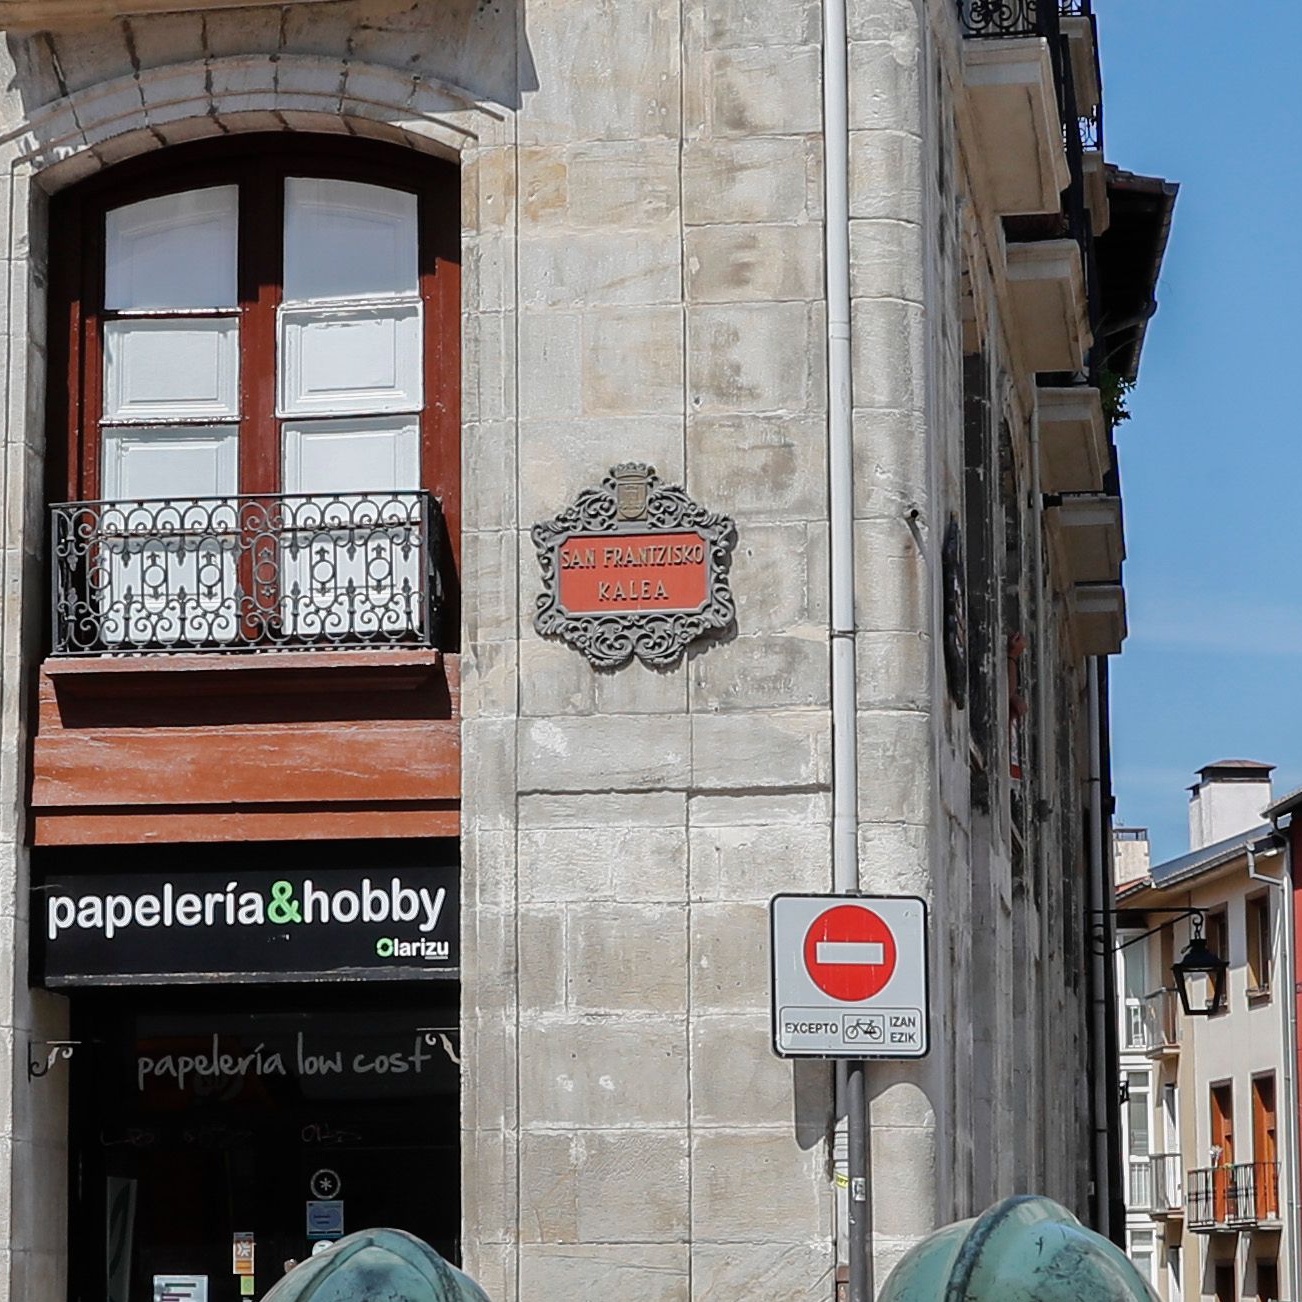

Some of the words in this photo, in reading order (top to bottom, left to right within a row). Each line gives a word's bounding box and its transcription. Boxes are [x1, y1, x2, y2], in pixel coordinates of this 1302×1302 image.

[561, 549, 596, 570] SAN
[603, 544, 704, 568] FRANTZISKO
[598, 580, 669, 602] KALEA
[48, 878, 446, 939] papelería&hobby
[784, 1020, 838, 1036] EXCEPTO
[889, 1016, 916, 1029] IZAN
[890, 1031, 916, 1044] EZIK
[138, 1033, 285, 1090] papelería
[297, 1031, 341, 1075] low
[353, 1035, 433, 1075] cost
